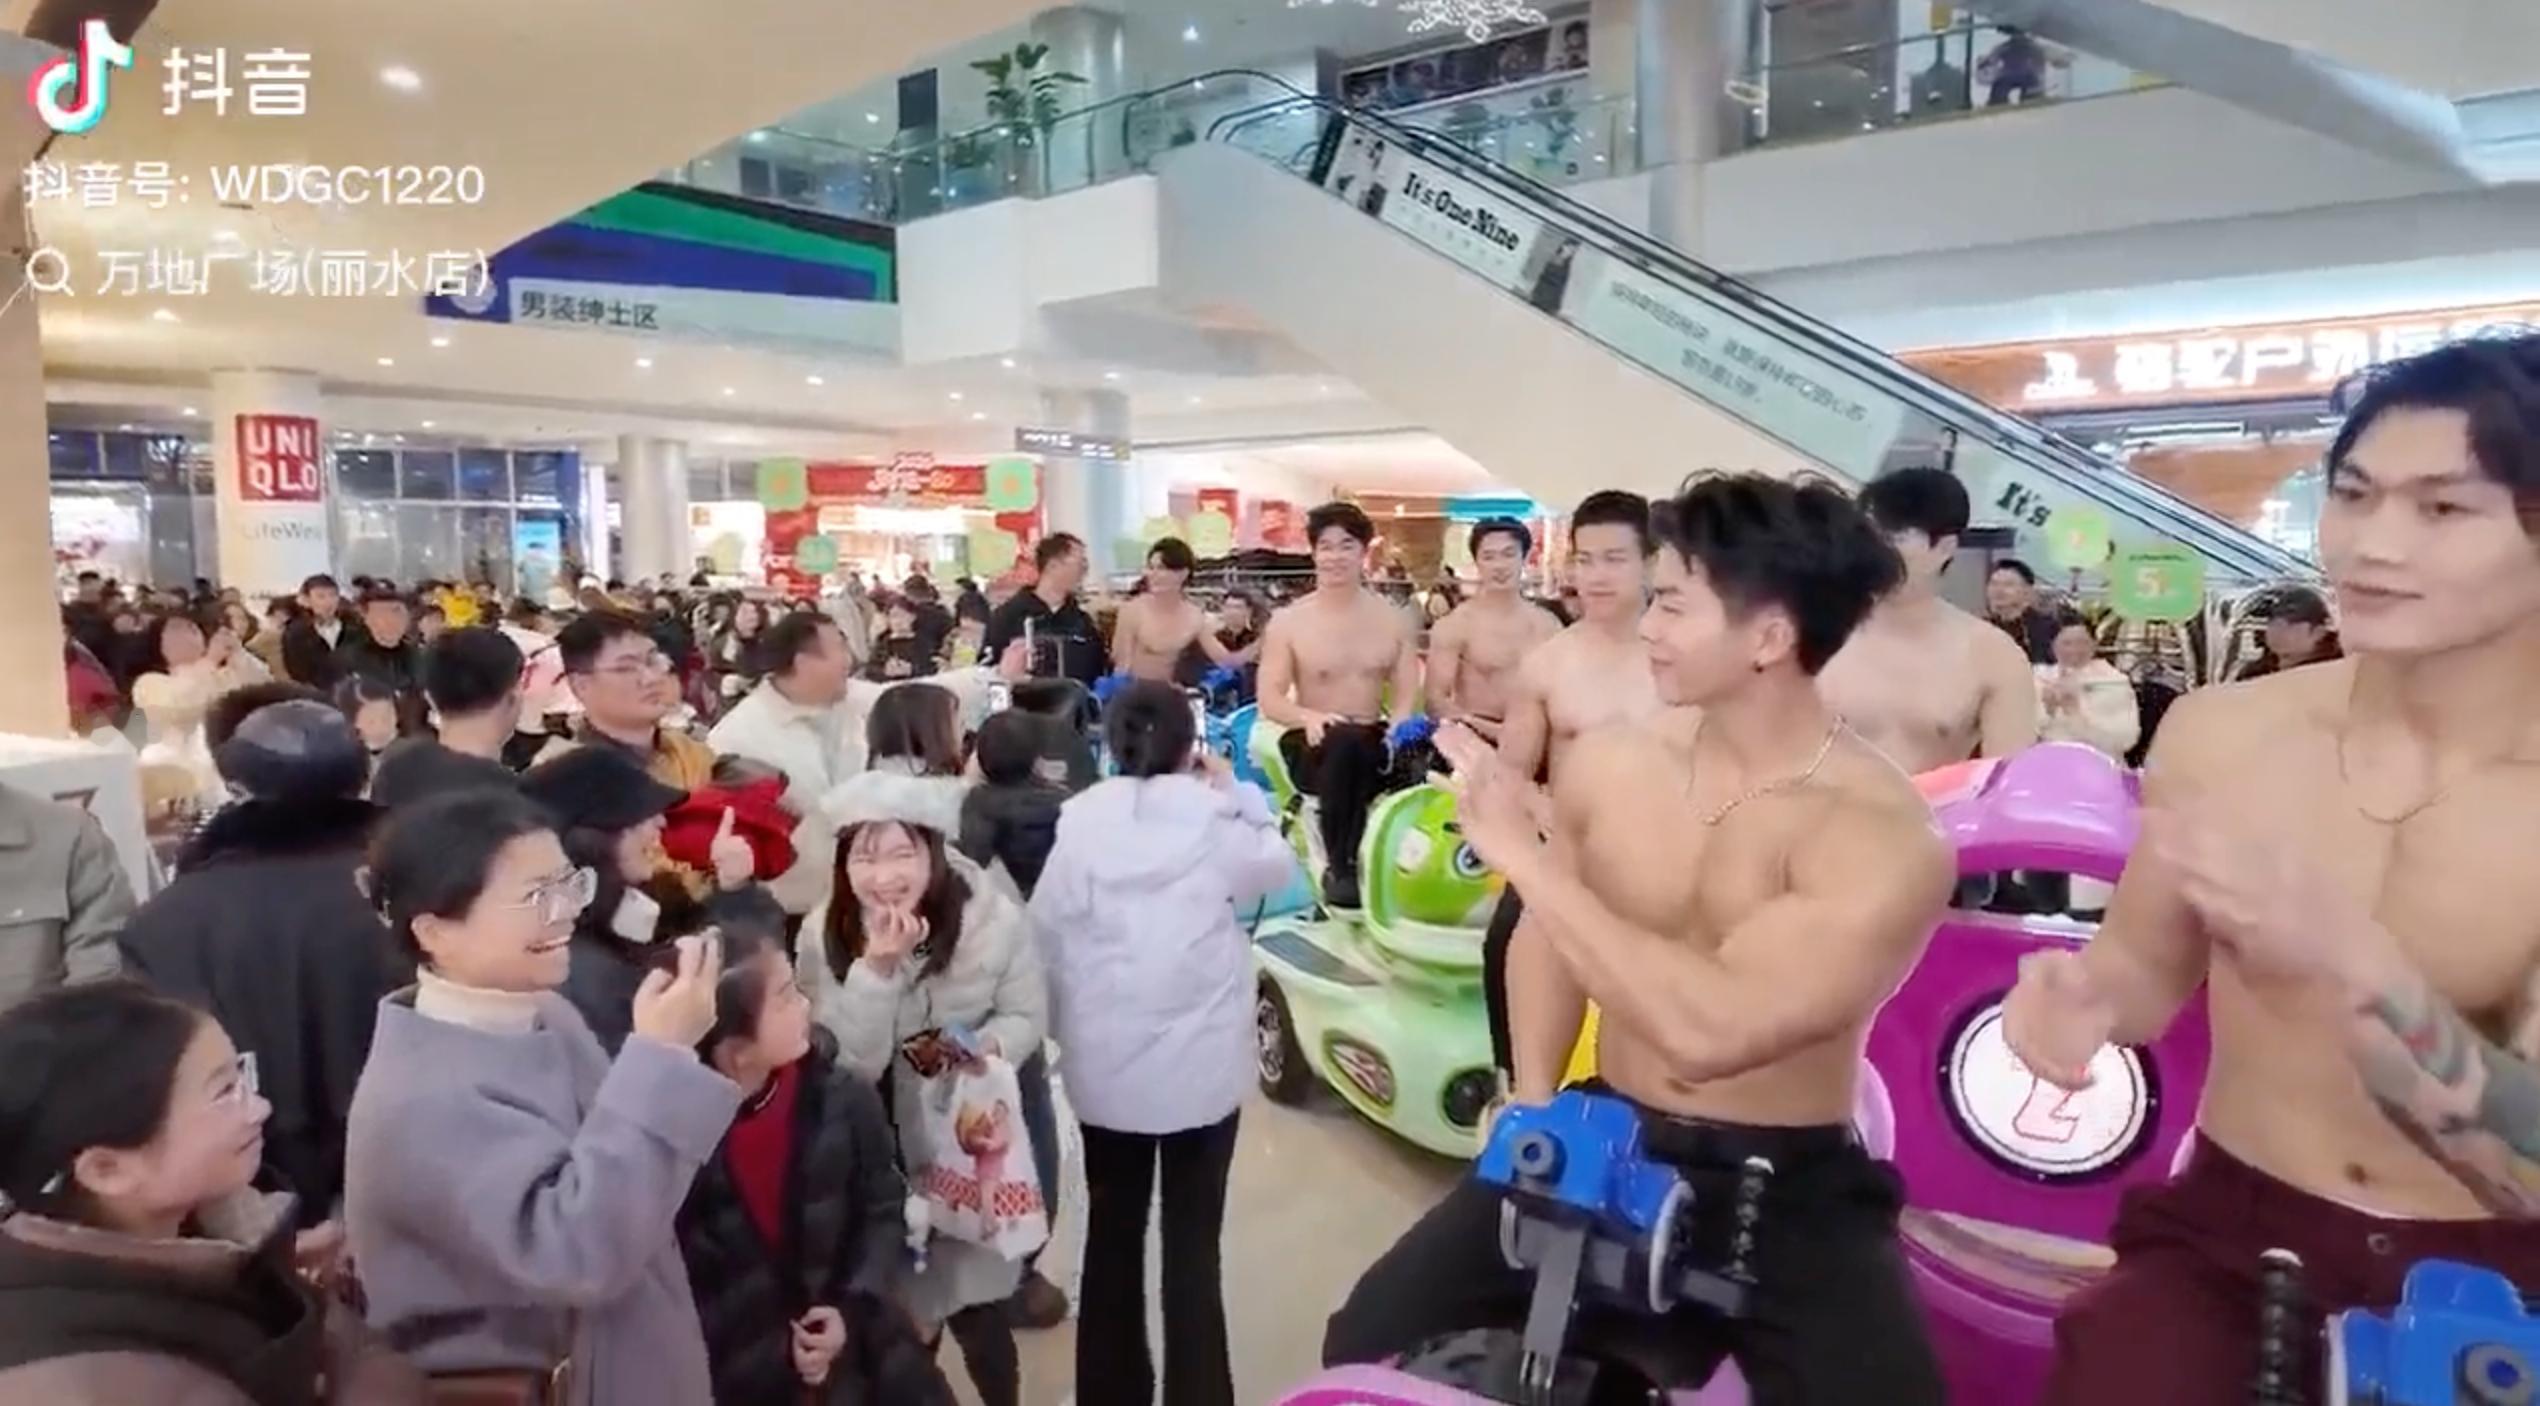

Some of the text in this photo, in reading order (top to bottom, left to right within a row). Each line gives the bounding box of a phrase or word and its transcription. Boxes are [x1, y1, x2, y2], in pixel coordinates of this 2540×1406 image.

[520, 290, 660, 330] 男装绅士区
[245, 420, 313, 457] UNI
[250, 458, 319, 496] QLO
